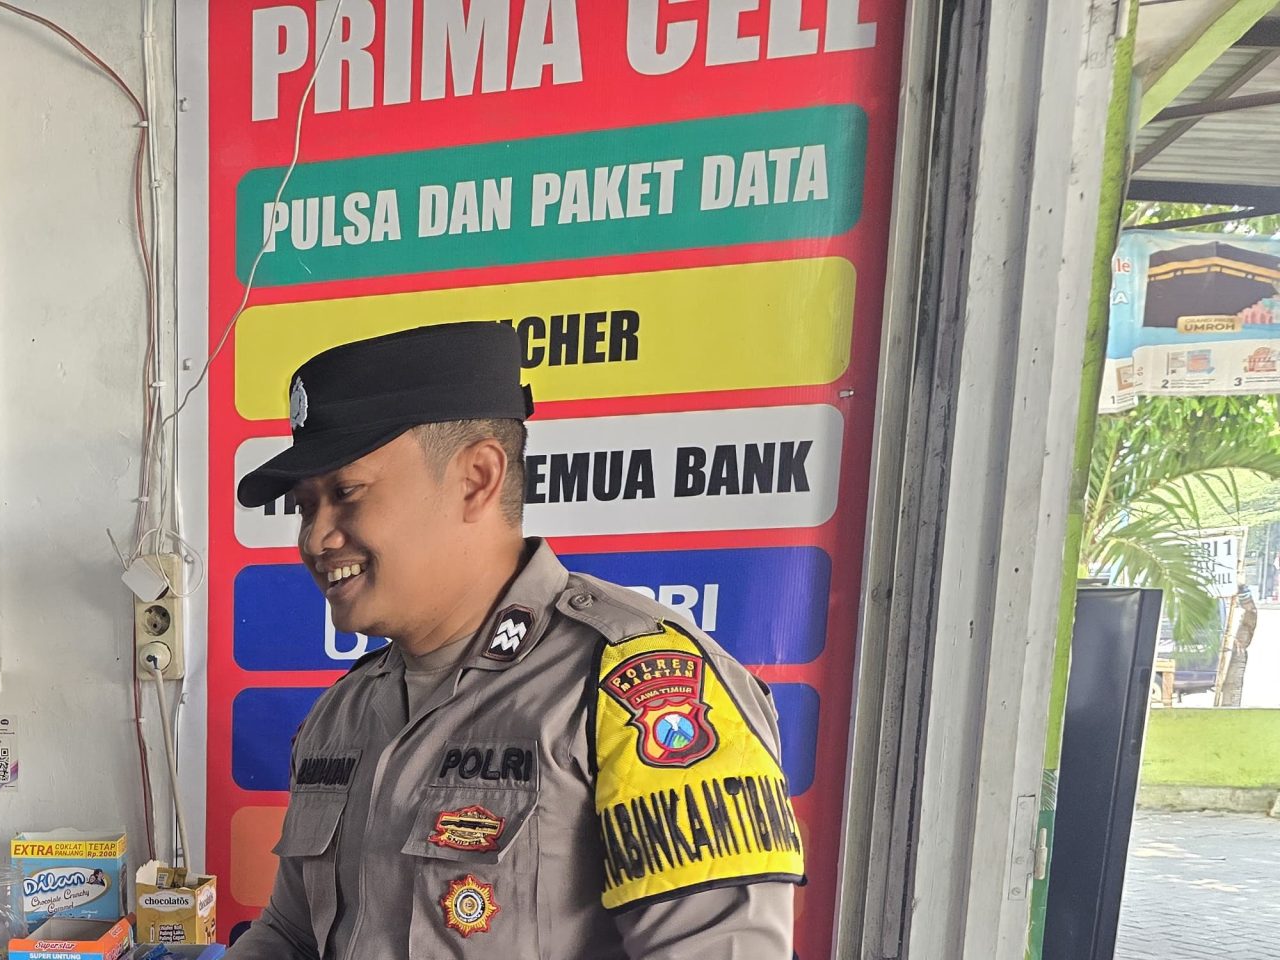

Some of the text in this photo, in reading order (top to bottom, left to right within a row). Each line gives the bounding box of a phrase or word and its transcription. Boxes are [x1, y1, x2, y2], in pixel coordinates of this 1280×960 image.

[250, 0, 583, 122] PRIMA
[264, 144, 829, 252] PULSA DAN PAKET DATA
[510, 310, 640, 369] CHER
[1184, 323, 1235, 332] UMROH
[524, 440, 813, 504] EMUA BANK
[612, 658, 695, 688] POLRES
[621, 669, 693, 692] MAGETAN
[634, 686, 692, 703] JAWA TIMUR
[439, 748, 533, 782] POLRI
[14, 845, 53, 855] EXTRA
[23, 872, 86, 896] Dilan
[35, 941, 75, 952] Superstar
